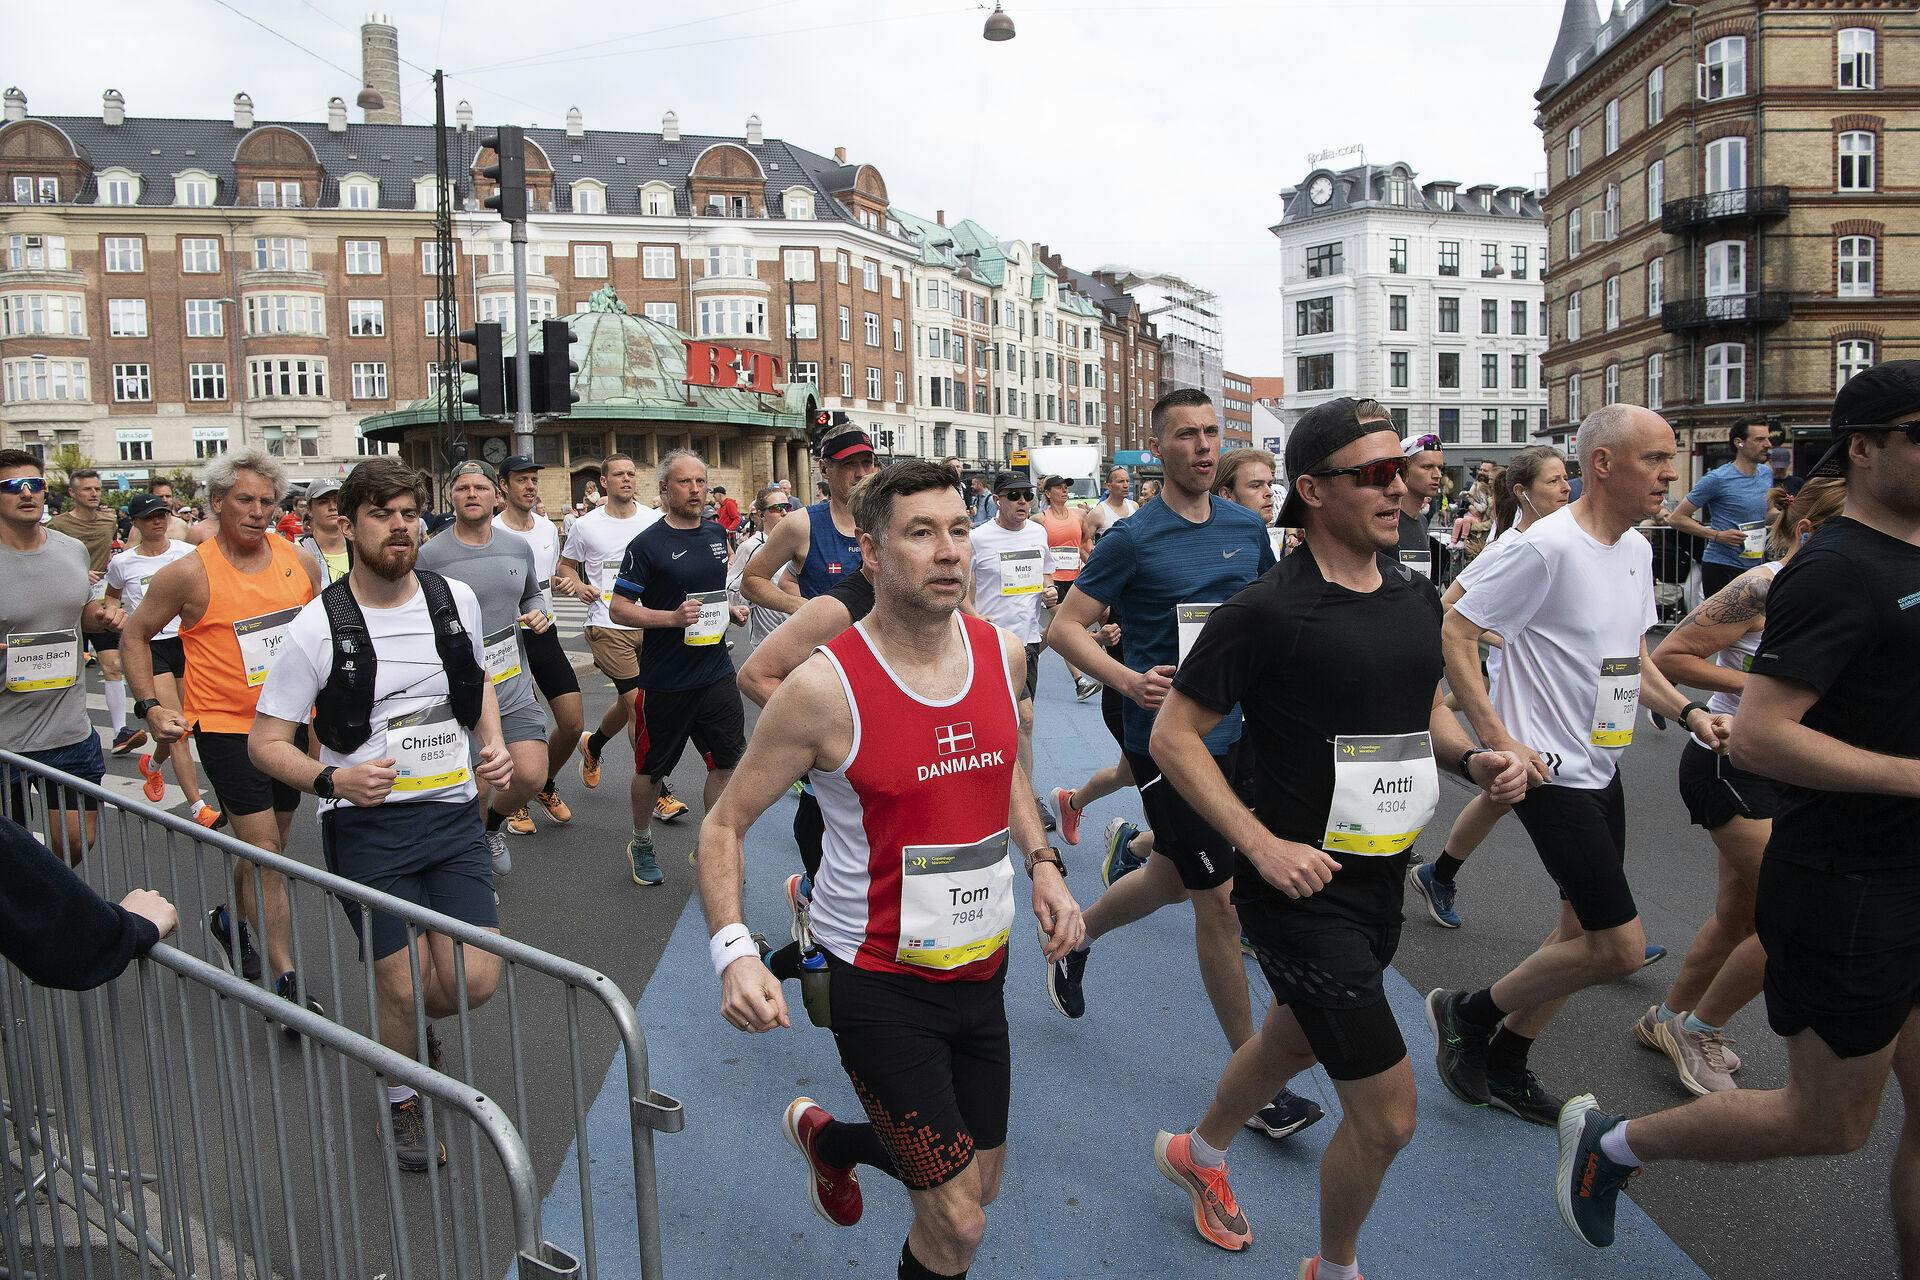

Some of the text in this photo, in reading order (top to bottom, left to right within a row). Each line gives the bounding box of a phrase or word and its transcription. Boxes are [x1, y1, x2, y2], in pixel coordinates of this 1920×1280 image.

[700, 609, 721, 619] Søren
[14, 650, 71, 664] Jonas Bach
[32, 662, 53, 670] 7639
[401, 732, 457, 750] Christian
[420, 749, 445, 762] 6853
[917, 749, 1005, 782] DANMARK
[1372, 775, 1413, 795] Antti
[1376, 799, 1407, 813] 4304
[1198, 850, 1216, 874] FUSION
[948, 886, 990, 906] Tom
[951, 907, 984, 926] 7984
